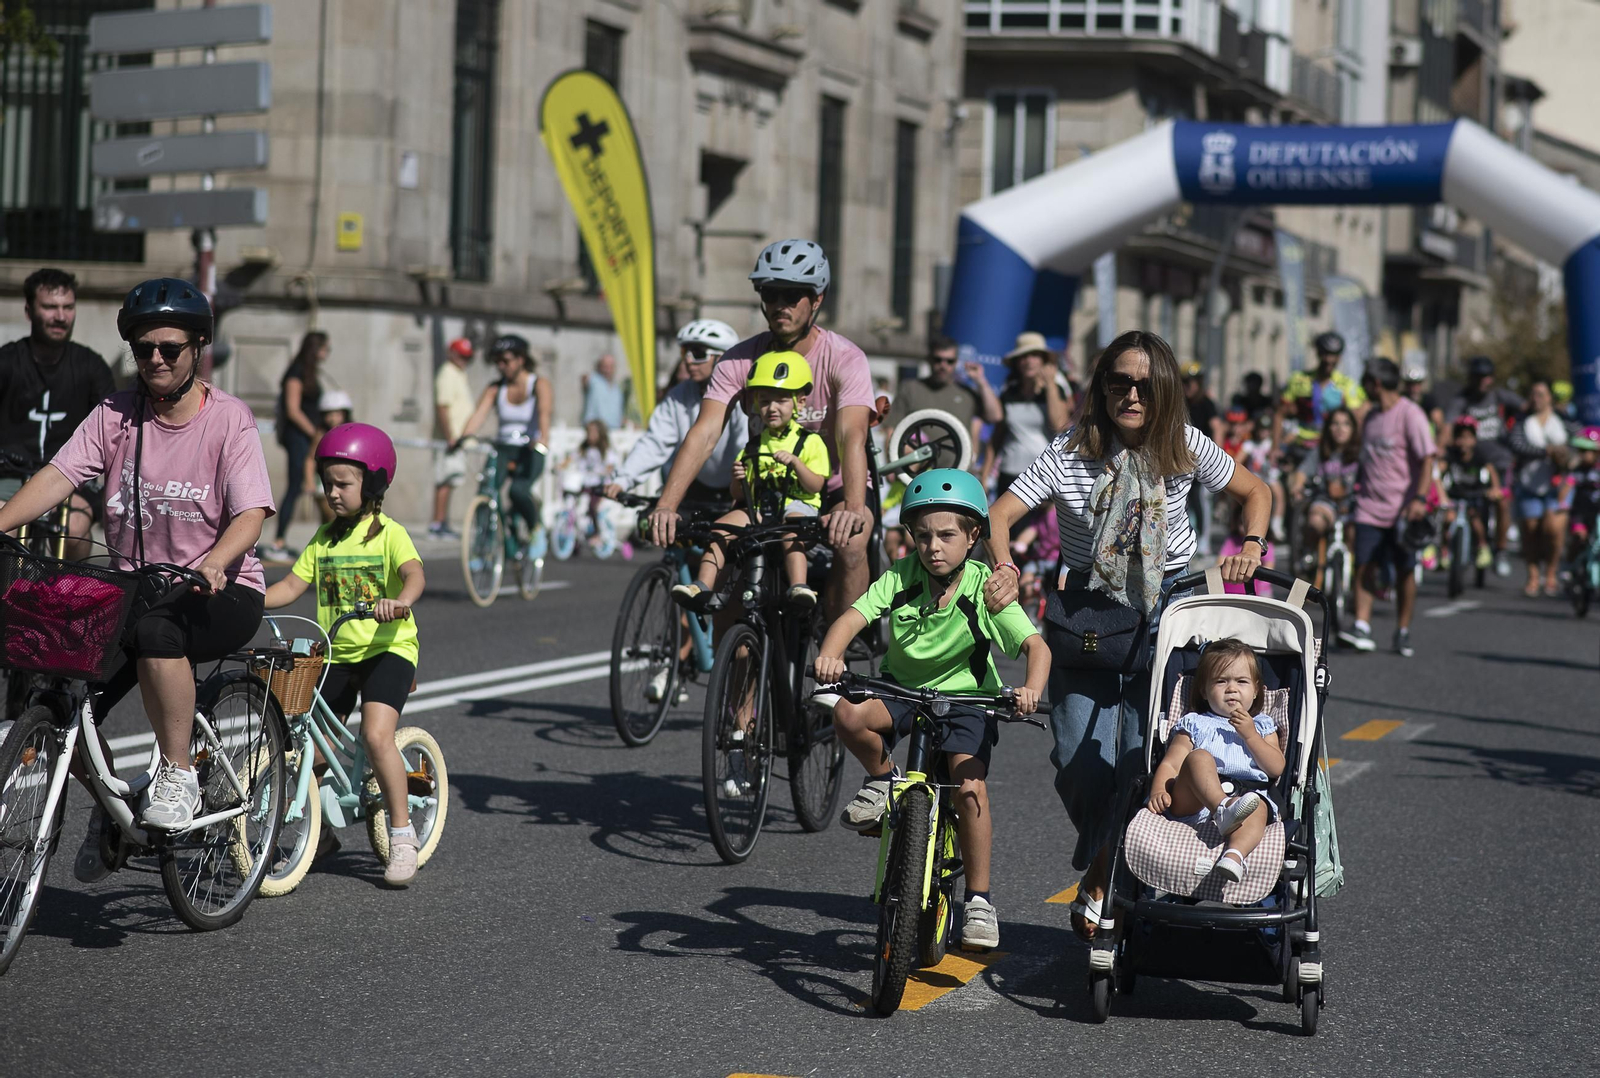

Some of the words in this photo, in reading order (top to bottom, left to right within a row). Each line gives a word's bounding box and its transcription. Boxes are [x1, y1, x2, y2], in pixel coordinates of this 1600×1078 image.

[1250, 136, 1418, 165] DEPUTACIÓN
[1248, 167, 1371, 189] OURENSE
[582, 157, 637, 267] DEPORTE
[164, 480, 210, 501] Bici
